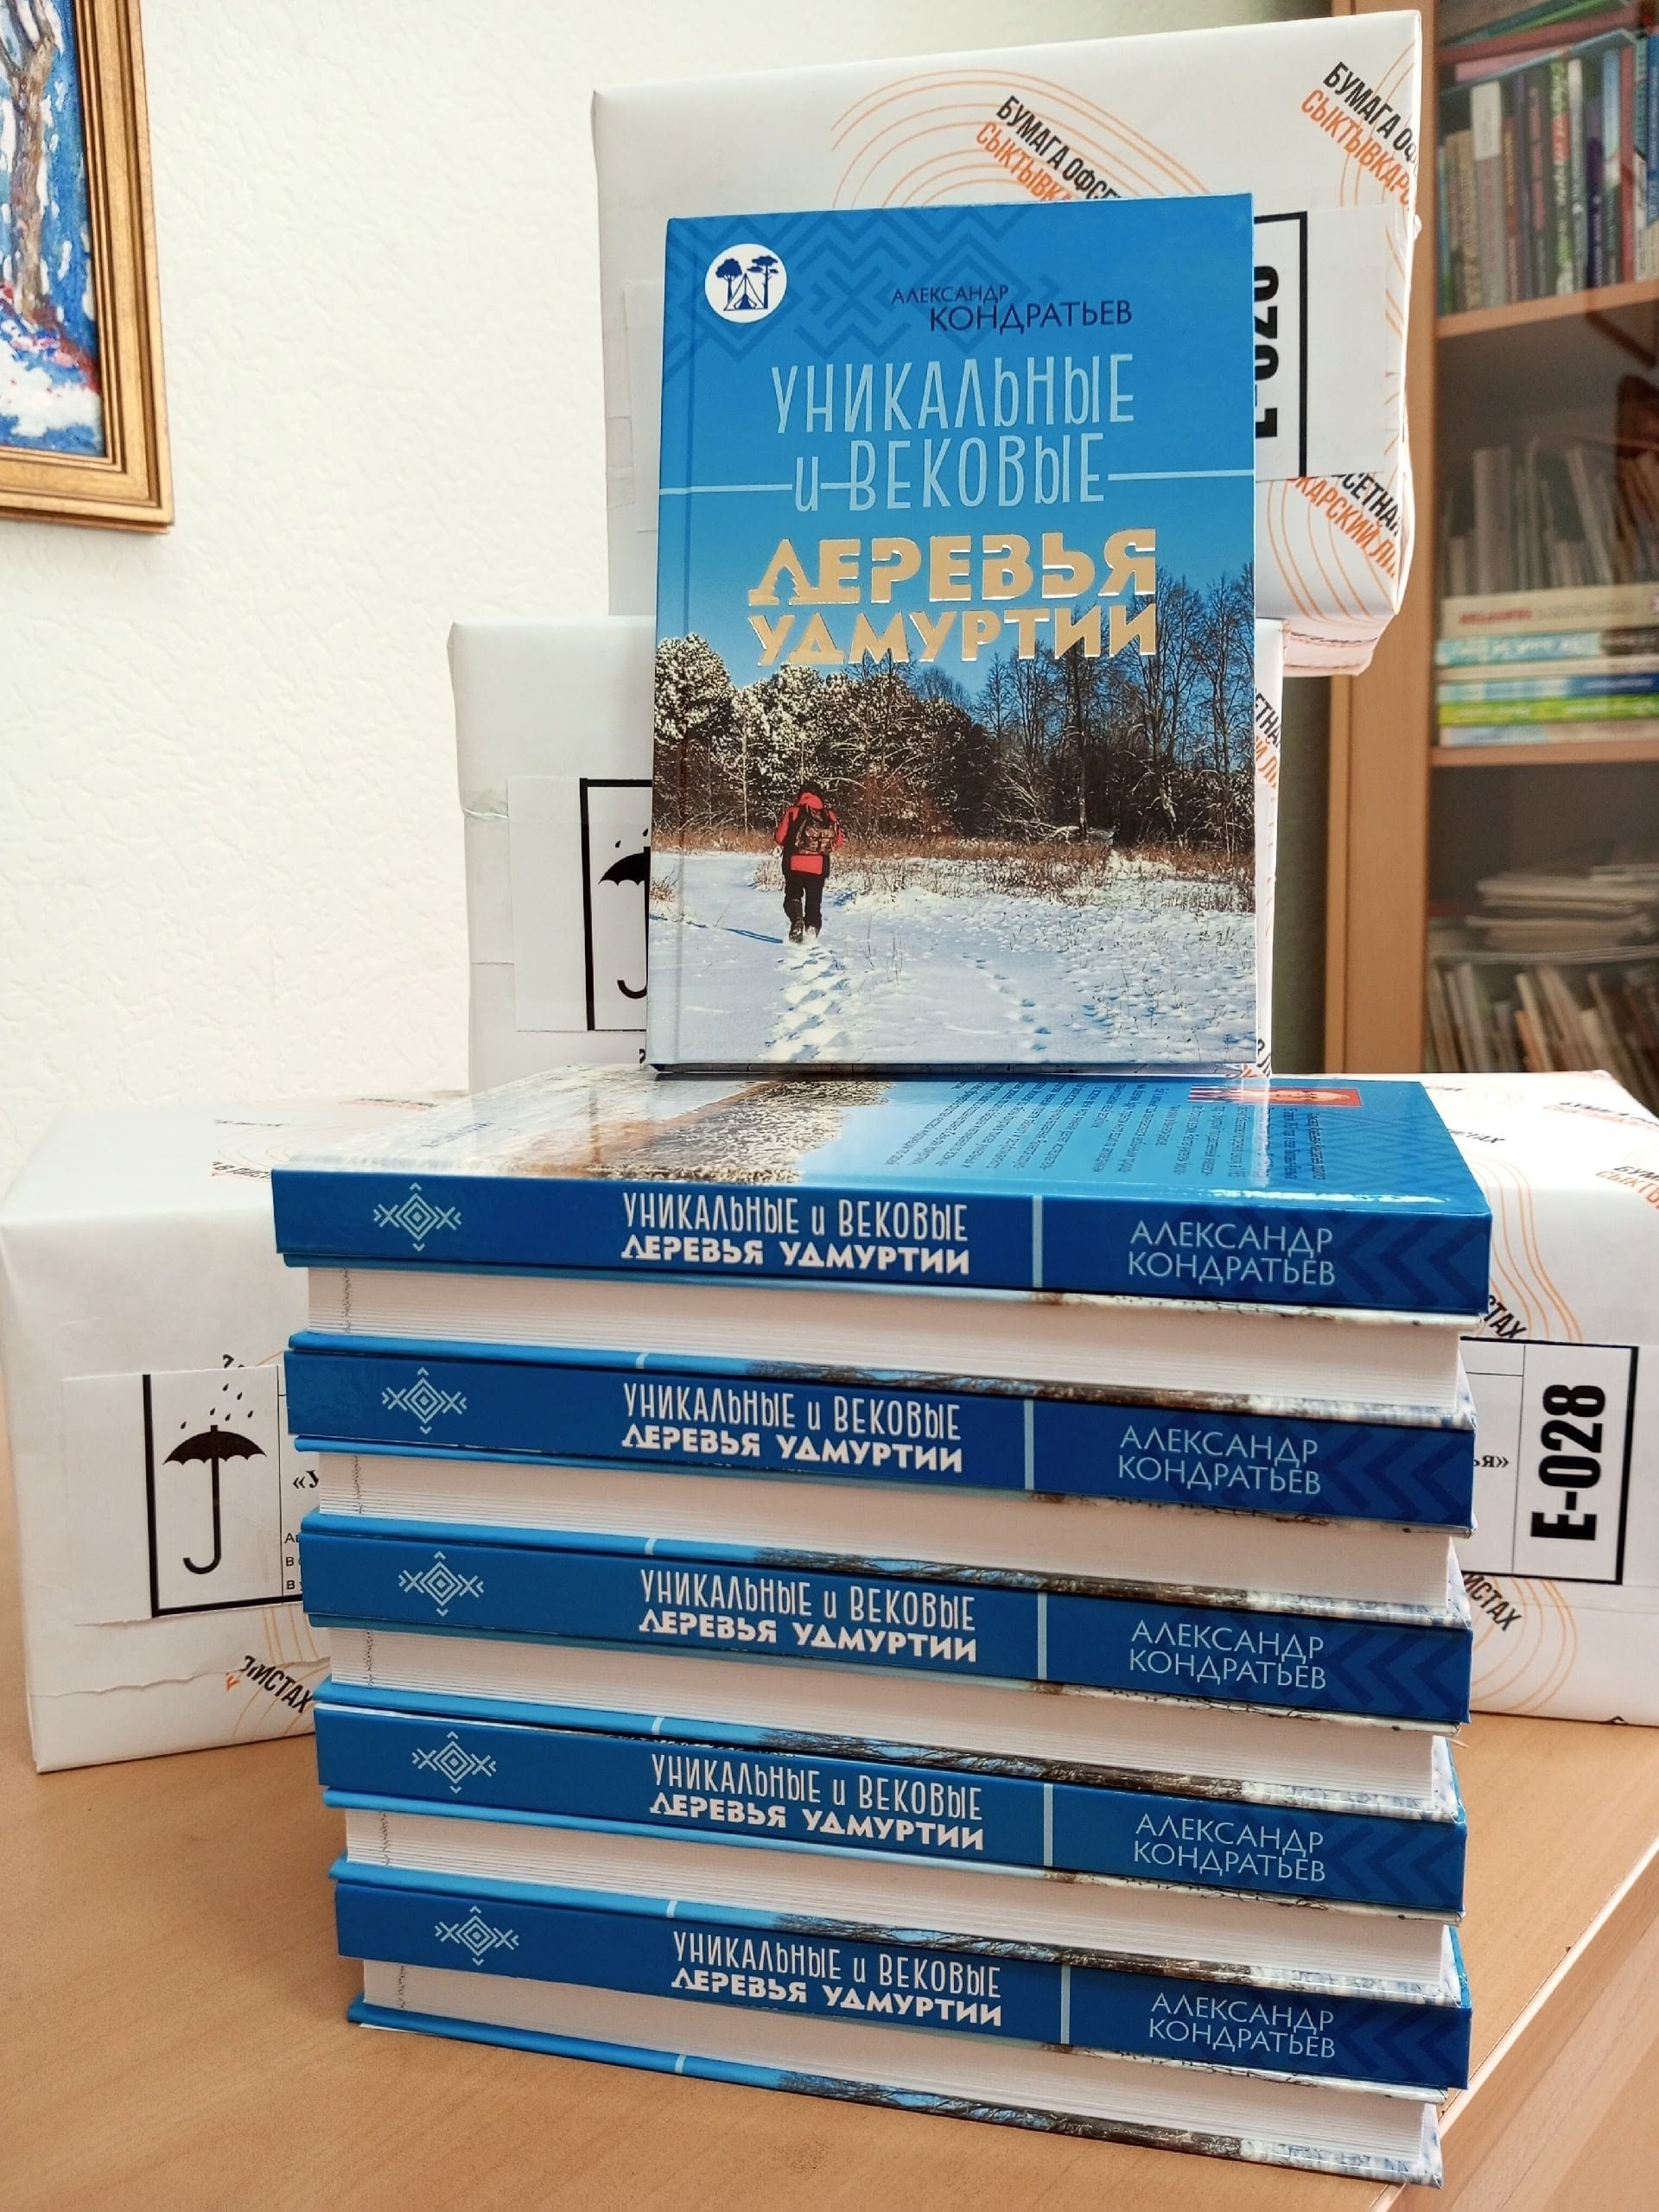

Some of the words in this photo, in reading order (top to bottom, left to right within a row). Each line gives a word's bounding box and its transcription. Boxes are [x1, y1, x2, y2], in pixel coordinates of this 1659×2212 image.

[1323, 61, 1402, 140] БУМАГА
[996, 95, 1071, 171] БУМАГА
[1062, 157, 1122, 200] ОФС
[892, 284, 1009, 305] АЛЕКСАНДР
[931, 300, 1133, 334] КОНДРАТЬЕВ
[772, 353, 1135, 433] УНИКАЛЬНЫЕ
[849, 433, 1105, 512] ВЕКОВЫЕ
[747, 528, 1157, 607] ДЕРЕВЬЯ
[747, 604, 1157, 666] УДМУРТИИ
[622, 1192, 799, 1234] УНИКАЛЬНЫЕ
[838, 1198, 969, 1242] ВЕКОВЫЕ
[1129, 1219, 1333, 1258] АЛЕКСАНДР
[621, 1235, 764, 1265] ДЕРЕВЬЯ
[779, 1241, 969, 1275] УДМУРТИИ
[1128, 1251, 1336, 1287] КОНДРАТЬЕВ
[622, 1382, 796, 1430] УНИКАЛЬНЫЕ
[835, 1395, 962, 1440] ВЕКОВЫЕ
[622, 1424, 760, 1457] ДЕРЕВЬЯ
[776, 1434, 963, 1473] УДМУРТИИ
[1120, 1425, 1318, 1468] АЛЕКСАНДР
[1119, 1454, 1321, 1495] КОНДРАТЬЕВ
[640, 1568, 811, 1617] УНИКАЛЬНЫЕ
[850, 1585, 976, 1631] ВЕКОВЫЕ
[639, 1609, 777, 1643] ДЕРЕВЬЯ
[792, 1622, 976, 1662] УДМУРТИИ
[1131, 1619, 1324, 1664] АЛЕКСАНДР
[1129, 1648, 1326, 1690] КОНДРАТЬЕВ
[652, 1753, 820, 1803] УНИКАЛЬНЫЕ
[858, 1774, 982, 1821] ВЕКОВЫЕ
[650, 1791, 786, 1828] ДЕРЕВЬЯ
[802, 1808, 984, 1852] УДМУРТИИ
[1135, 1813, 1324, 1858] АЛЕКСАНДР
[1134, 1840, 1325, 1883] КОНДРАТЬЕВ
[672, 1930, 842, 1980] УНИКАЛЬНЫЕ
[879, 1953, 1001, 1999] ВЕКОВЫЕ
[671, 1967, 807, 2004] ДЕРЕВЬЯ
[822, 1986, 1002, 2027] УДМУРТИИ
[1151, 1992, 1334, 2035] АЛЕКСАНДР
[1149, 2018, 1336, 2058] КОНДРАТЬЕВ
